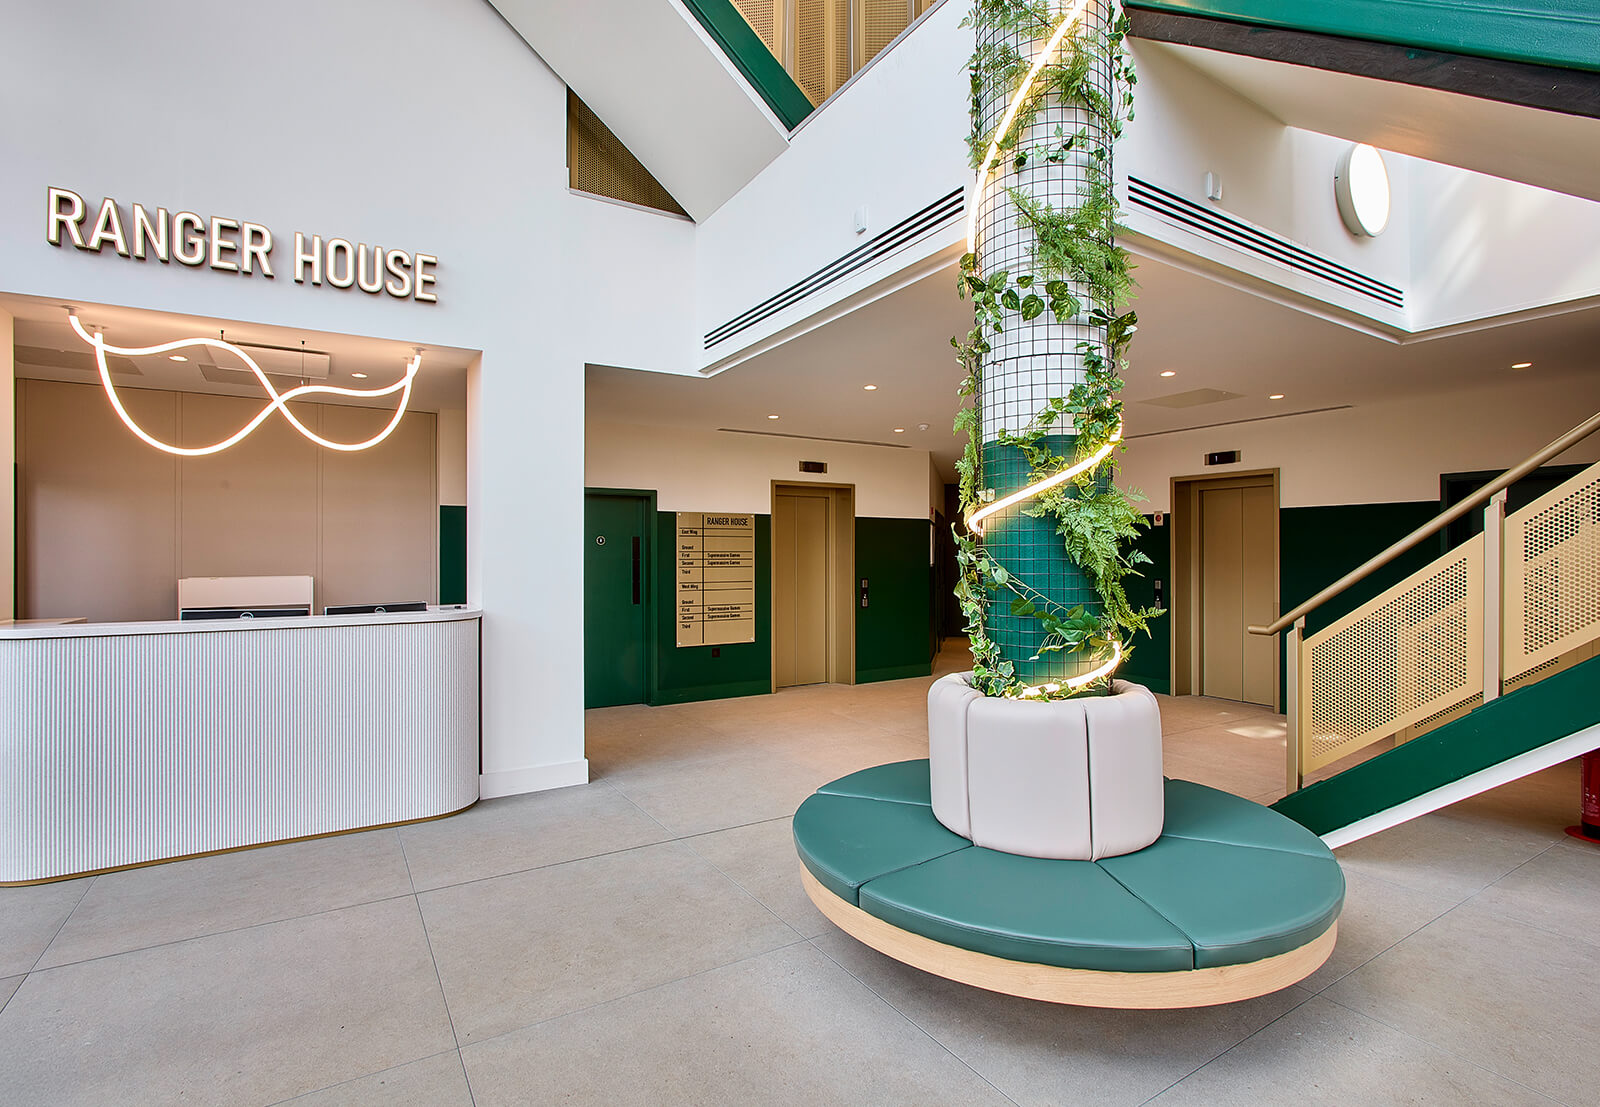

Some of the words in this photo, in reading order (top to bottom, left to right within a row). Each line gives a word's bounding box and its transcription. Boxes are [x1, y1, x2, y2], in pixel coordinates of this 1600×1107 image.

[47, 186, 275, 278] RANGER
[294, 231, 438, 303] HOUSE
[707, 517, 729, 525] RANGER
[731, 518, 748, 526] HOUSE
